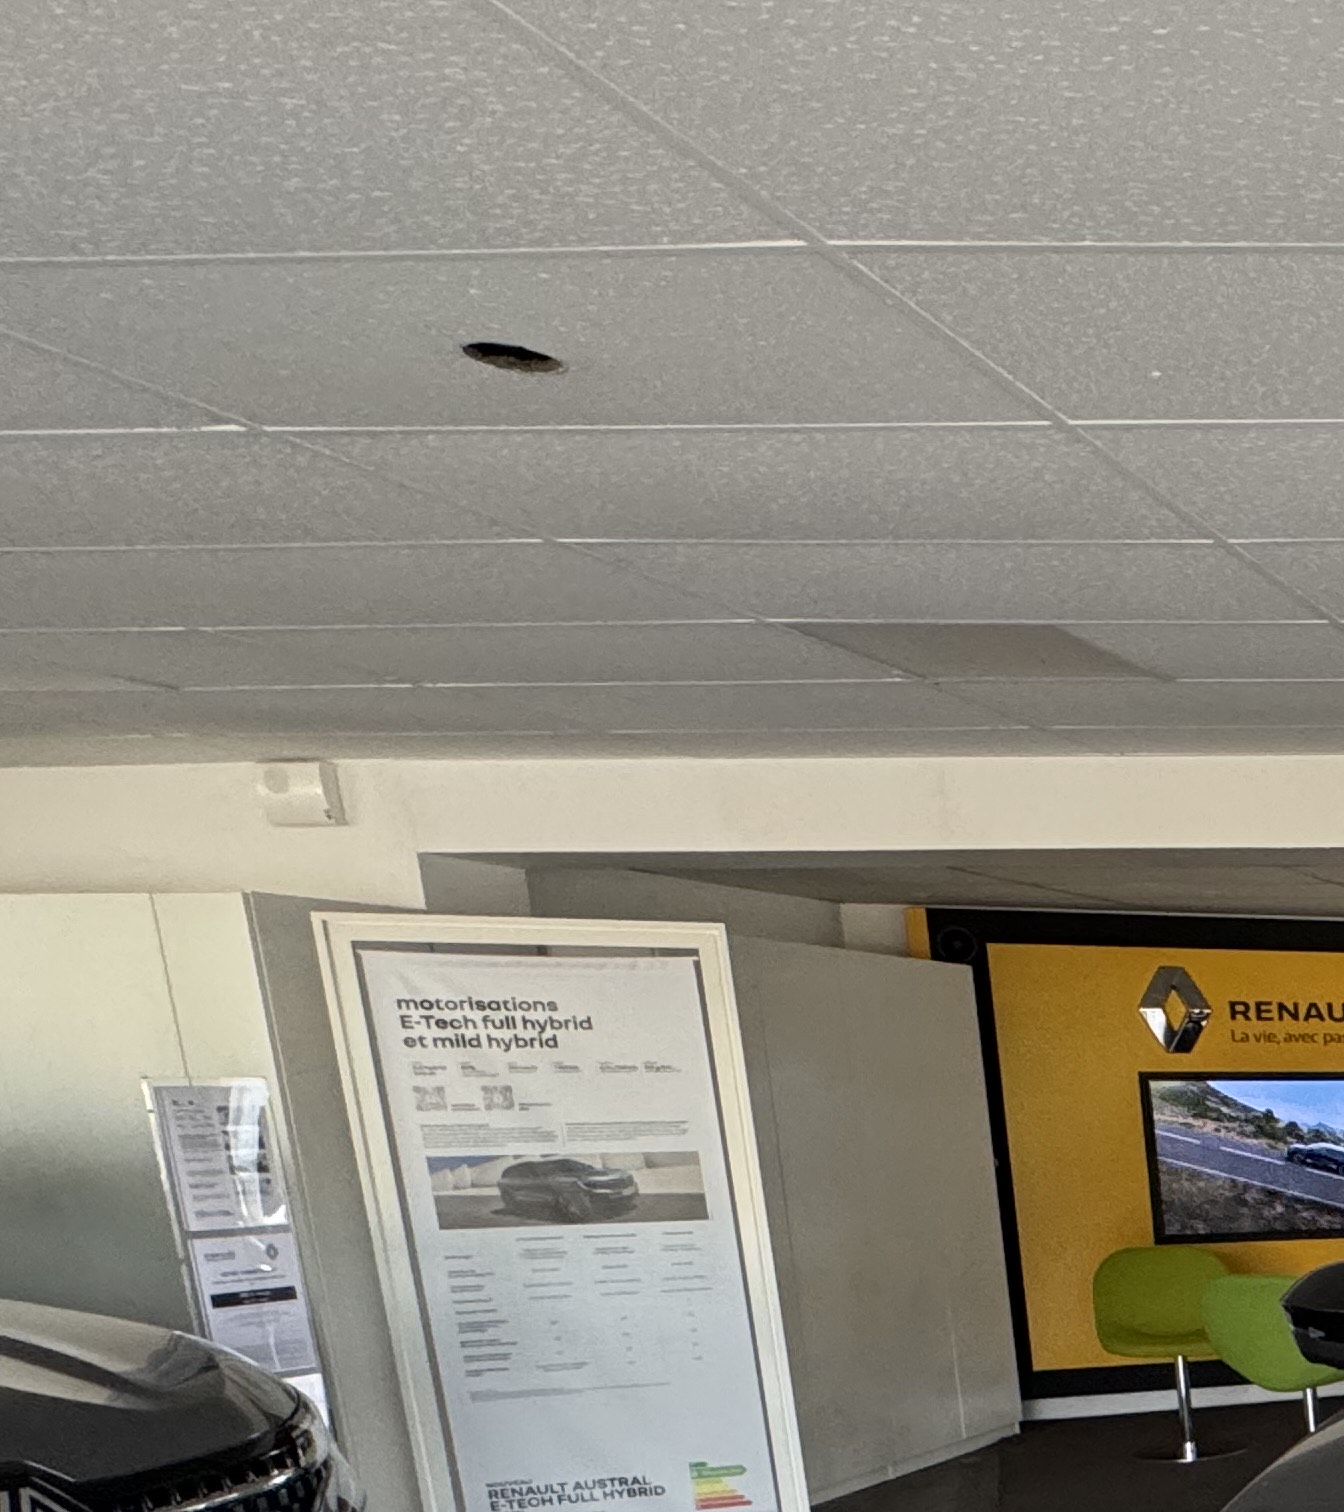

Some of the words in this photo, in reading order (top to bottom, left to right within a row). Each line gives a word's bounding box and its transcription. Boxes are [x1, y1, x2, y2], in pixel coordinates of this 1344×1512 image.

[396, 996, 559, 1012] motorisations
[400, 1014, 478, 1030] E-Tech
[482, 1014, 518, 1030] full
[522, 1015, 594, 1033] hybrid
[402, 1034, 428, 1049] et
[432, 1033, 483, 1049] mild
[487, 1033, 559, 1052] hybrid
[1230, 1029, 1250, 1044] La
[1253, 1030, 1281, 1046] vie,
[1283, 1031, 1318, 1044] avec
[488, 1482, 568, 1500] RENAULT
[572, 1475, 653, 1492] AUSTRAL
[557, 1490, 600, 1506] FULL
[602, 1484, 666, 1501] HYBRID
